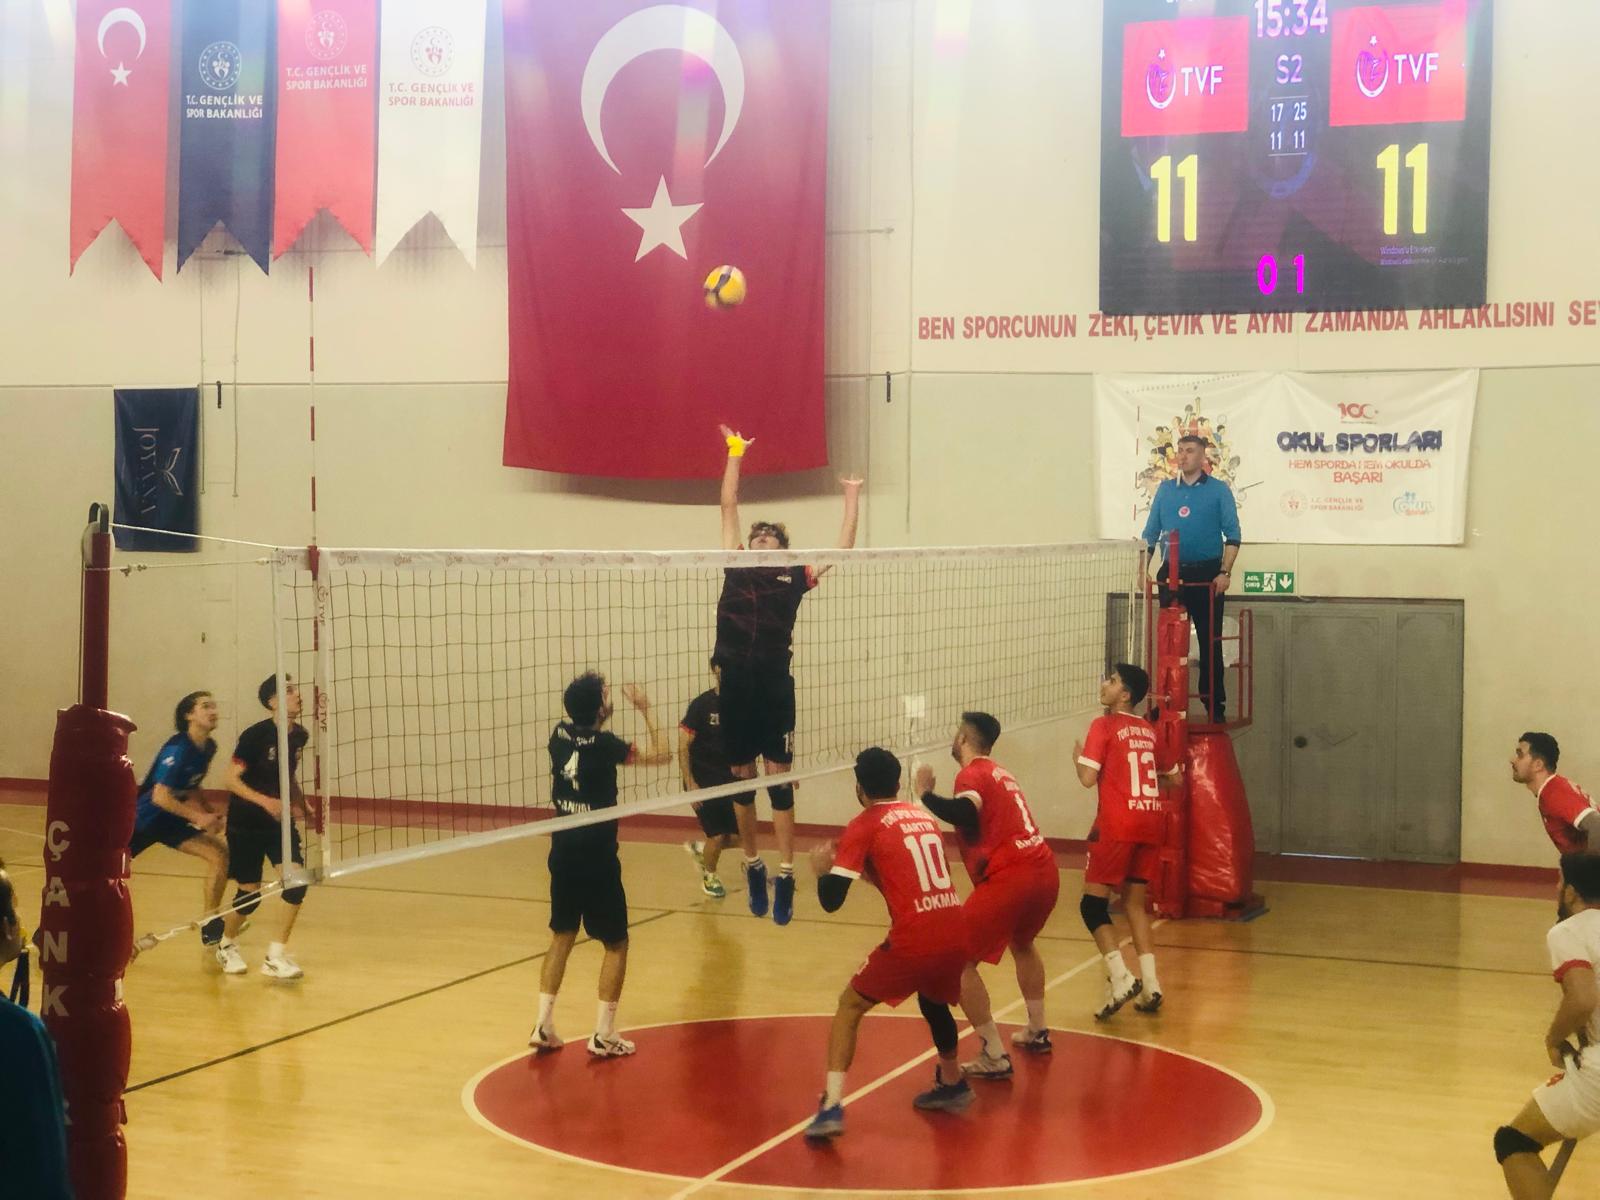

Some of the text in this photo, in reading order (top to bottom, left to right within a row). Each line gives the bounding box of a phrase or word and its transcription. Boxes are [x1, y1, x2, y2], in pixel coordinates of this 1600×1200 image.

[1254, 0, 1329, 38] 15:34
[306, 63, 350, 79] GENÇLİK
[354, 64, 367, 75] VE
[1276, 54, 1303, 84] S2
[1393, 52, 1440, 84] TVF
[286, 76, 367, 91] SPOR BAKANLIĞI
[461, 82, 474, 93] VE
[1181, 65, 1224, 96] TVF
[200, 93, 245, 108] GENÇLİK
[249, 95, 263, 105] VE
[388, 95, 473, 107] SPOR BAKANLIĞI
[1271, 101, 1307, 122] 17 25
[186, 106, 263, 119] SPOR BAKANLIĞI
[1270, 130, 1305, 150] 11 11
[1150, 154, 1198, 242] 11
[1376, 143, 1428, 235] 11
[1257, 254, 1304, 295] 0 1
[918, 316, 955, 340] BEN
[962, 314, 1077, 339] SPORCUNUN
[1211, 311, 1237, 335] VE
[1246, 310, 1293, 334] AYNI
[1305, 308, 1409, 333] ZAMANDA
[1418, 302, 1555, 330] AHLAKLISINI
[1567, 300, 1600, 326] SE
[1276, 430, 1442, 453] OKUL SPORLARI
[1289, 459, 1312, 470] HEM
[1314, 459, 1357, 470] SPORDA
[1385, 458, 1432, 470] OKULDA
[1333, 472, 1383, 485] BAŞARI
[1128, 751, 1160, 798] 13
[903, 833, 952, 892] 10
[914, 892, 963, 913] LOKMA
